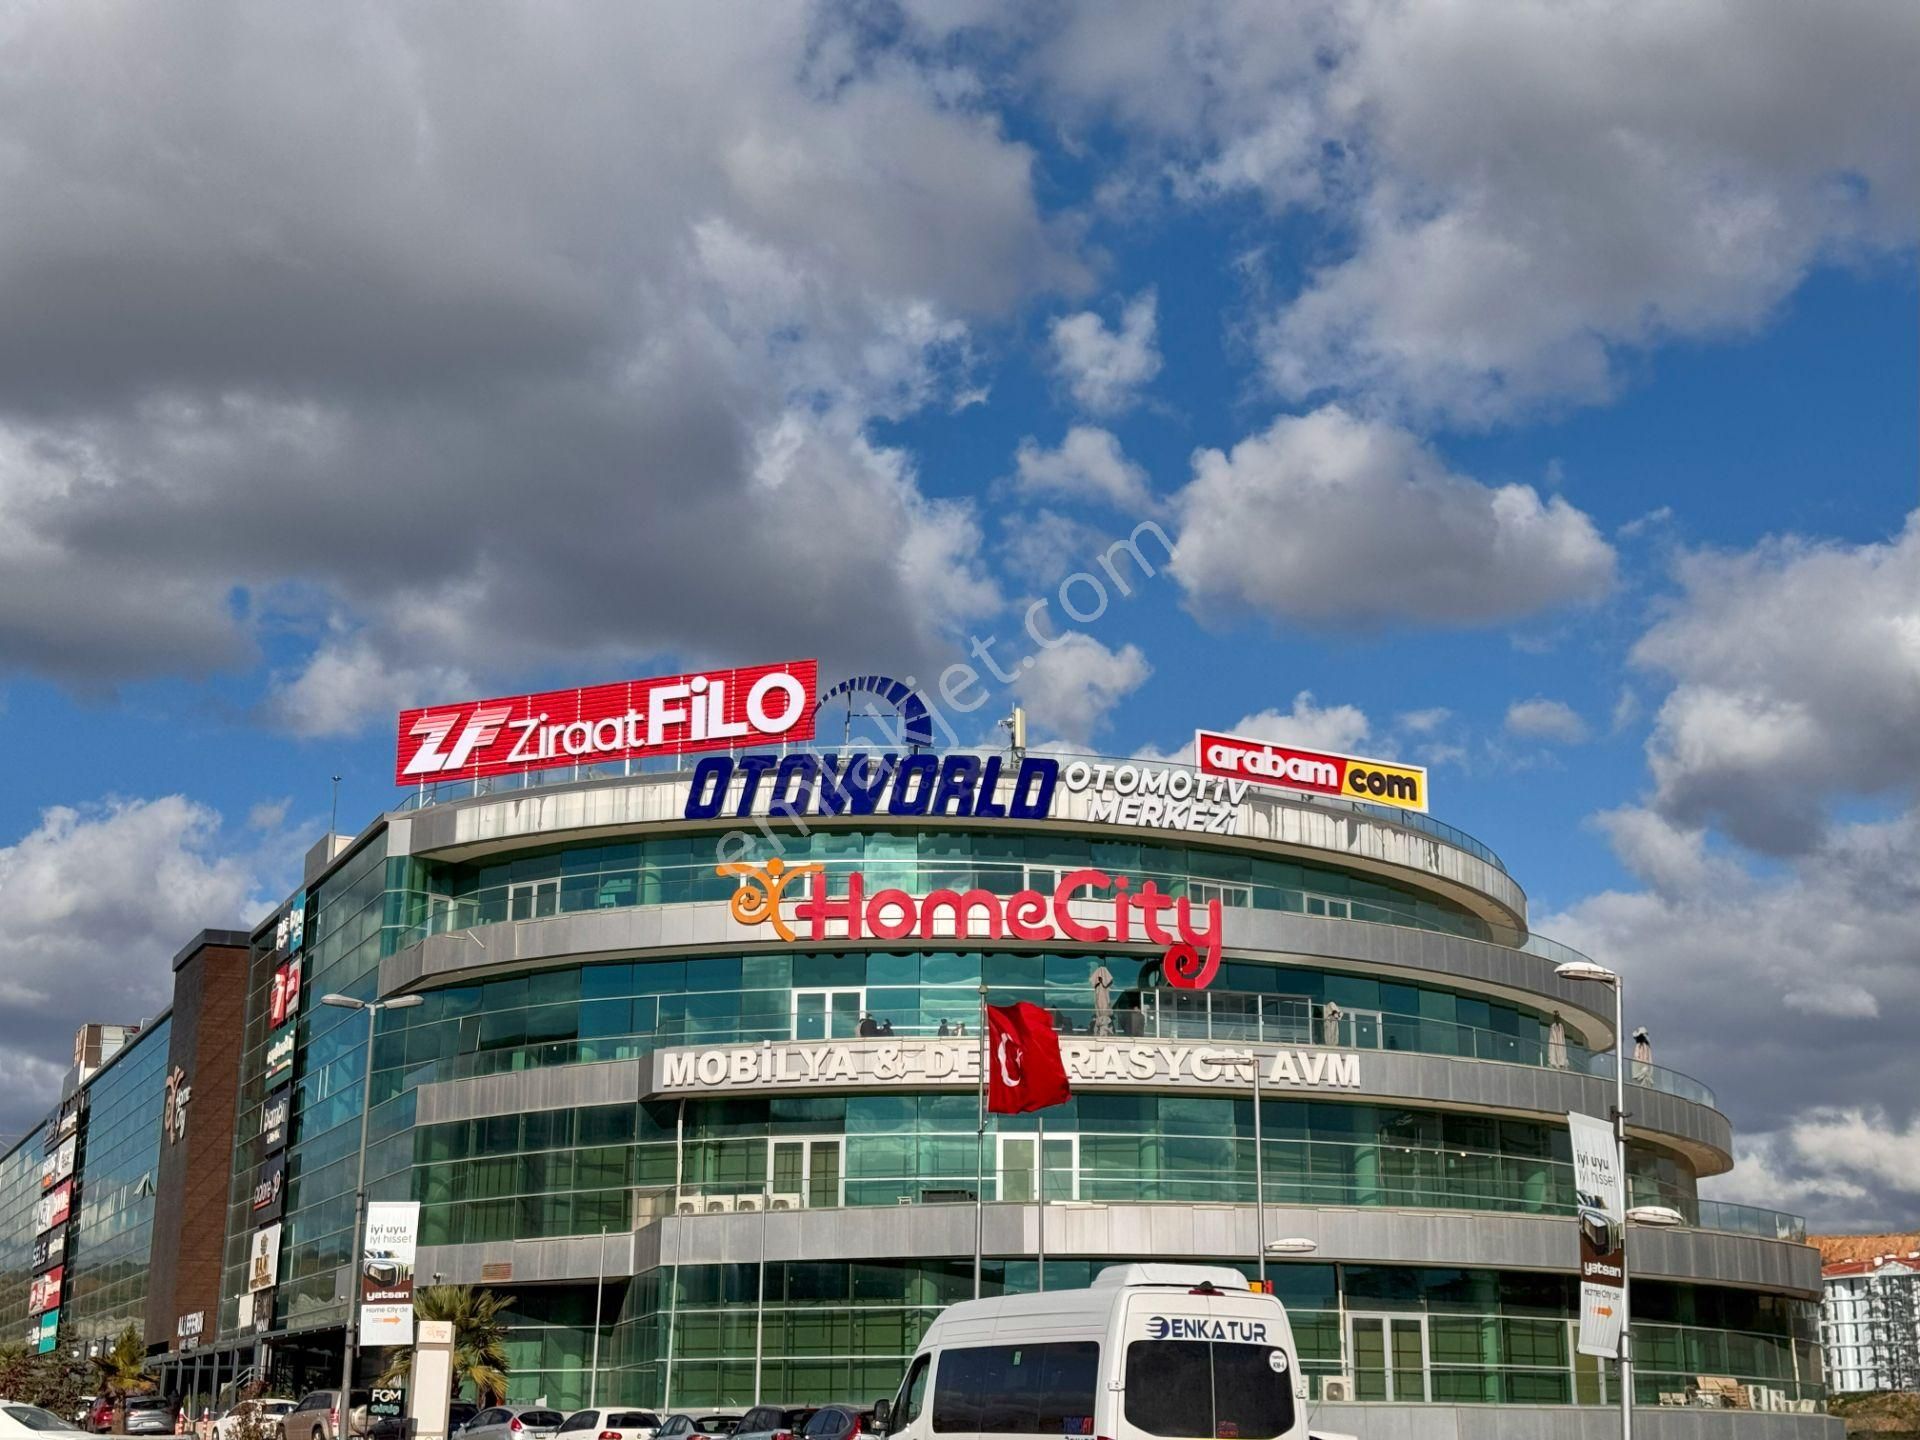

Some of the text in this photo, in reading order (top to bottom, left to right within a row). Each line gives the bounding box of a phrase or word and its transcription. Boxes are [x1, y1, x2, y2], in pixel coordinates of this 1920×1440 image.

[1207, 745, 1338, 787] arabam
[684, 753, 1060, 821] OTOWORLD
[663, 1040, 1361, 1087] MOBİLYA & DERASYON AVM
[371, 1224, 407, 1235] iyi uyu
[1584, 1261, 1622, 1278] yatsan
[366, 1290, 409, 1301] yatsan
